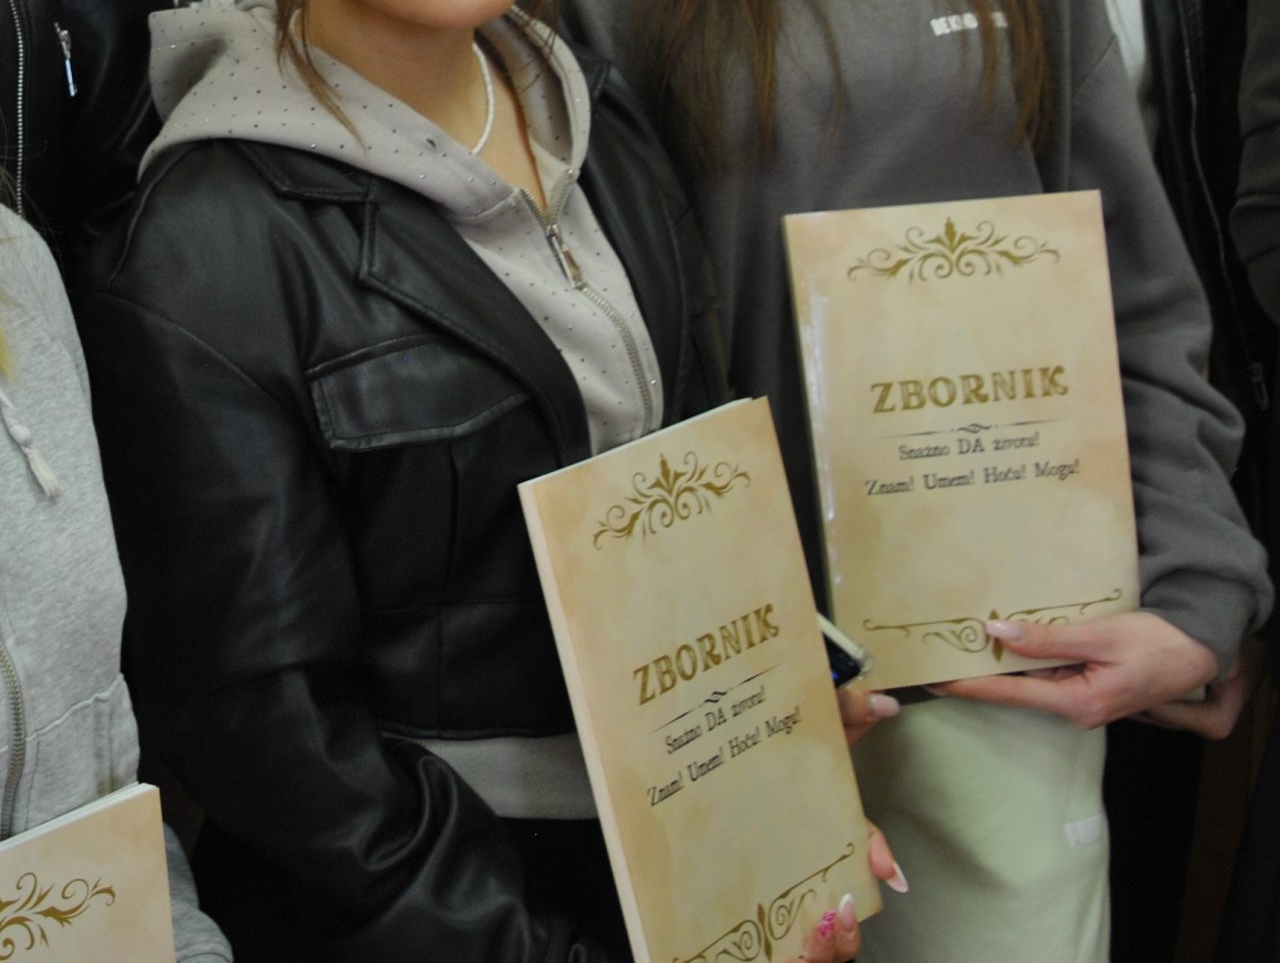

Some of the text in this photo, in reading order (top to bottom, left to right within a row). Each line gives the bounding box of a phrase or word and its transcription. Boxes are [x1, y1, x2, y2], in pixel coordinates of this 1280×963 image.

[871, 365, 1069, 414] ZBORNIK
[957, 438, 985, 455] DA
[865, 459, 1080, 496] Znam! Umem! Hoću! Mogu!
[632, 603, 780, 706] ZBORNIK
[705, 707, 727, 732] DA
[647, 706, 801, 806] Znam! Umem! Hoću! Mogu!
